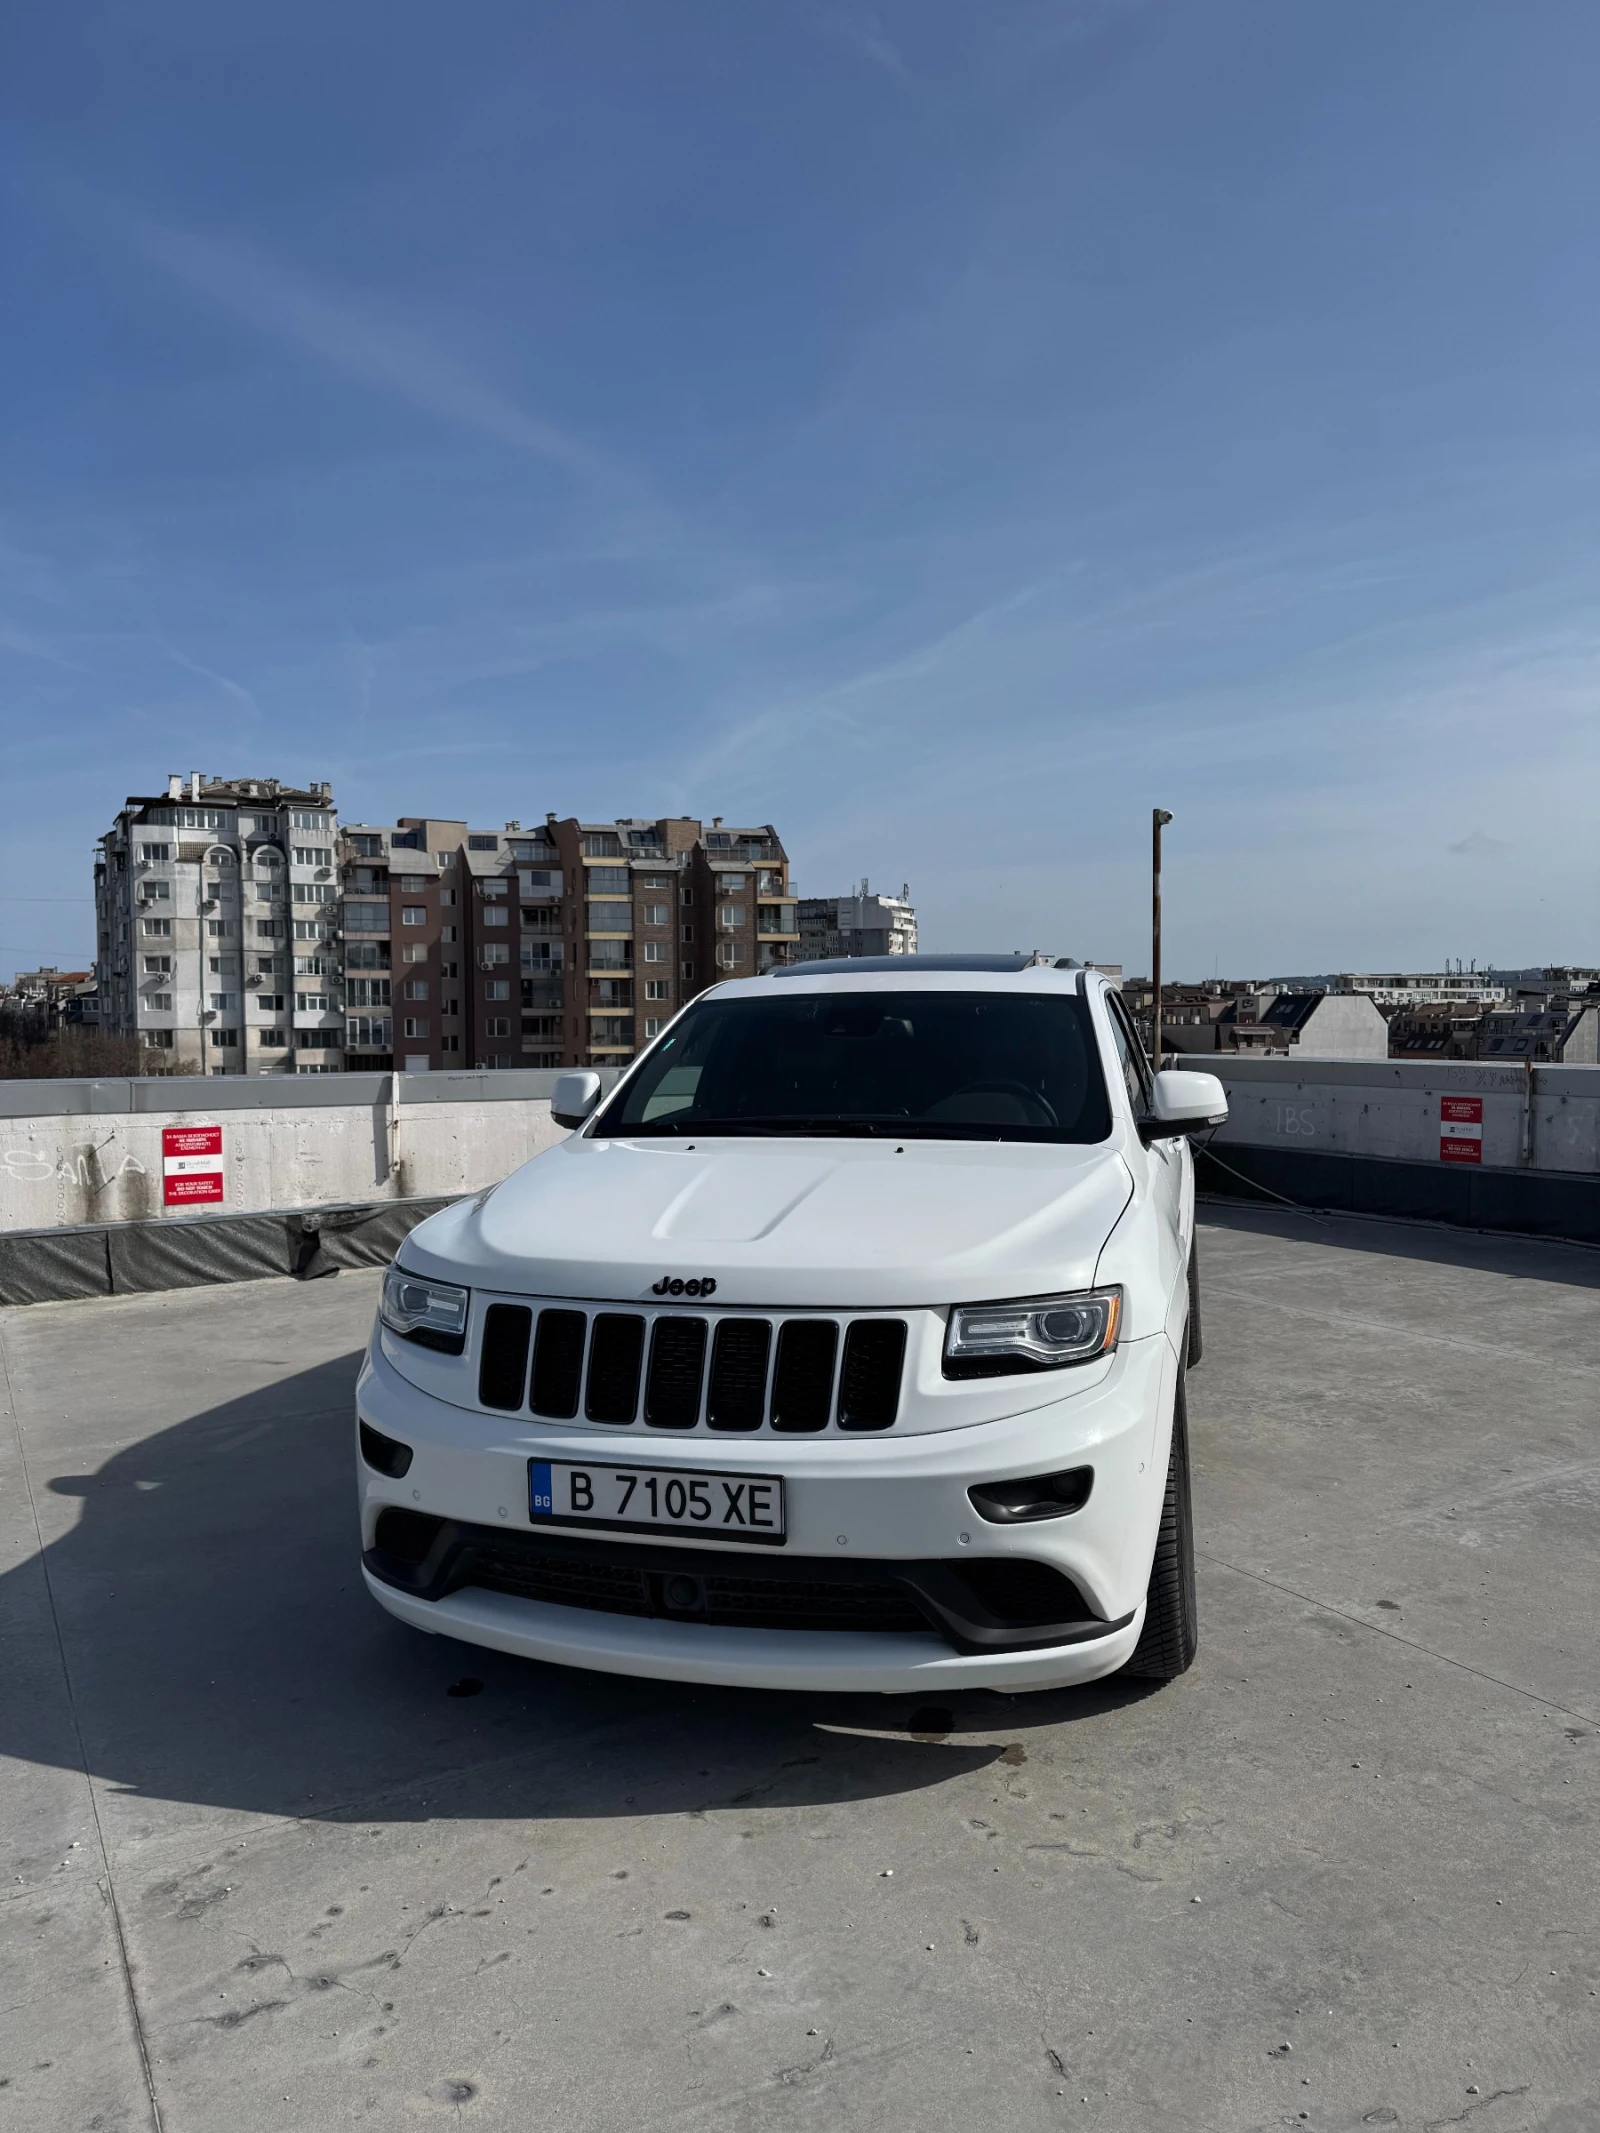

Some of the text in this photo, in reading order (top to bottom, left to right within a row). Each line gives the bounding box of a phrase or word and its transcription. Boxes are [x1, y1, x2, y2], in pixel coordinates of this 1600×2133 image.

[1276, 1106, 1316, 1136] IBS
[652, 1276, 717, 1297] Jeep
[534, 1471, 774, 1527] BG B 7105 XE
